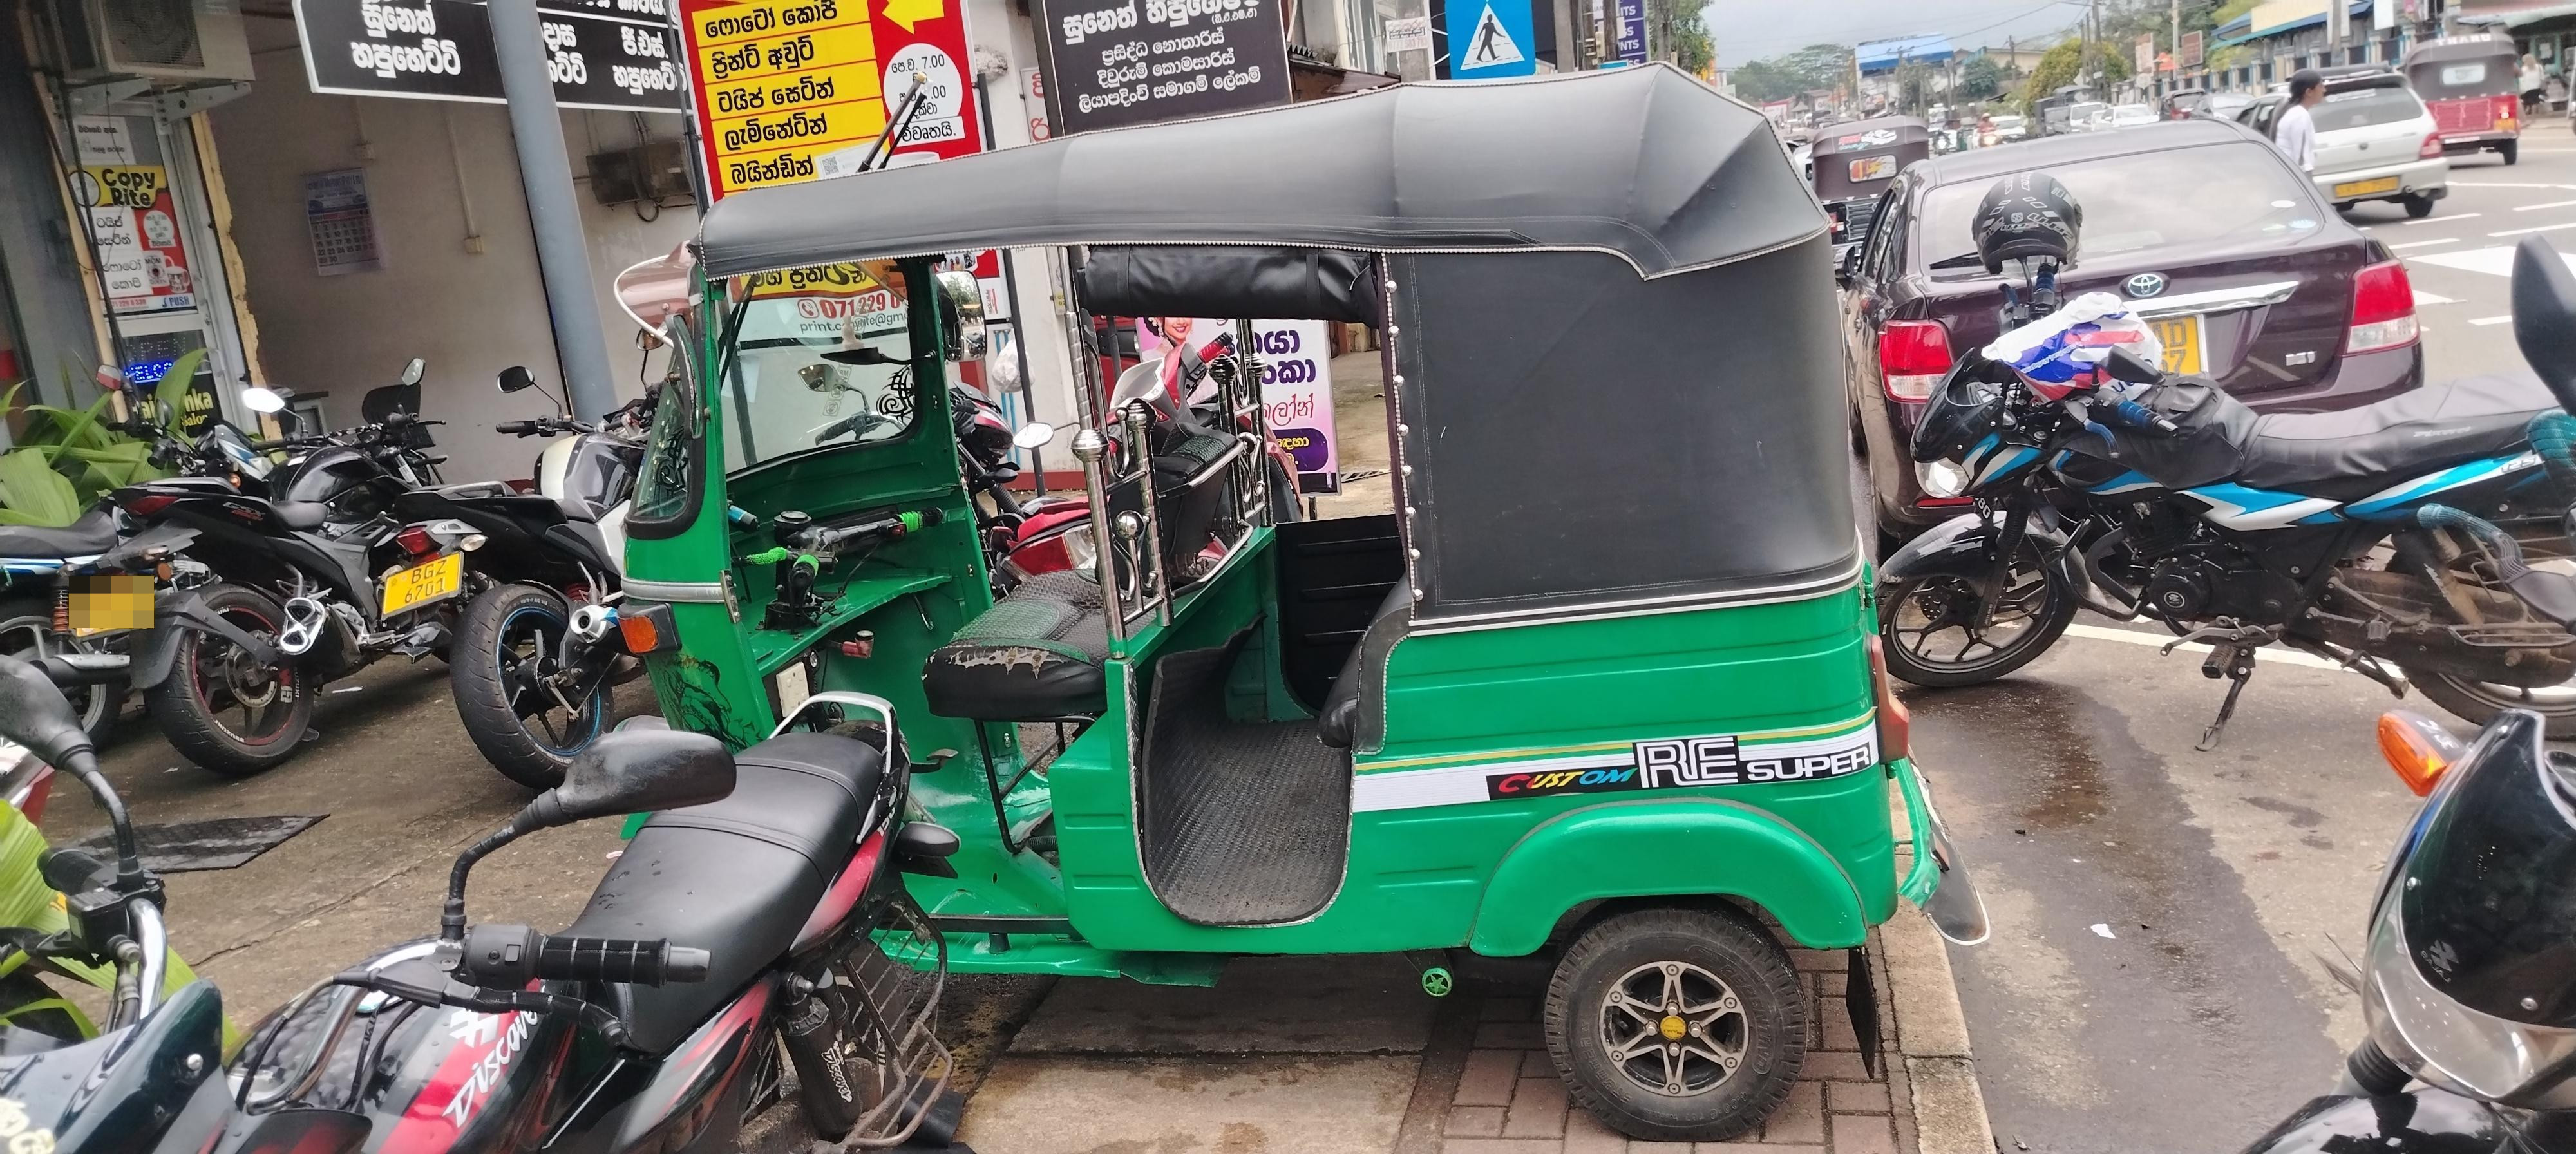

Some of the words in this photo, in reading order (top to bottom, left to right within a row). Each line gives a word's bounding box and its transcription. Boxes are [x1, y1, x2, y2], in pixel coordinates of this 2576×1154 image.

[1063, 1, 1137, 45] සුනෙත්
[350, 38, 461, 79] හපුහෙට්ටි
[768, 35, 814, 70] අවුට්
[1152, 28, 1225, 54] නොතාරිස්
[921, 54, 945, 69] 7.00
[1097, 61, 1148, 88] දිවුරුම්
[1152, 48, 1236, 77] කොමසාරිස්
[717, 86, 764, 113] ටයිප්
[772, 75, 834, 106] සෙටින්
[1079, 84, 1149, 113] ලියාපදිංචි
[1153, 75, 1208, 99] සමාගම්
[1213, 66, 1261, 91] ලේකම්
[725, 111, 827, 151] ලැමිනේටින්
[102, 169, 155, 191] Copy
[111, 187, 151, 205] Rite
[169, 296, 189, 306] PUSH
[819, 299, 855, 319] 071
[411, 559, 447, 585] BGZ
[404, 578, 444, 603] 6701
[1498, 768, 1638, 793] CUSTOM
[1638, 737, 1739, 788] RE
[1747, 747, 1870, 781] SUPER
[442, 1011, 538, 1128] Discov
